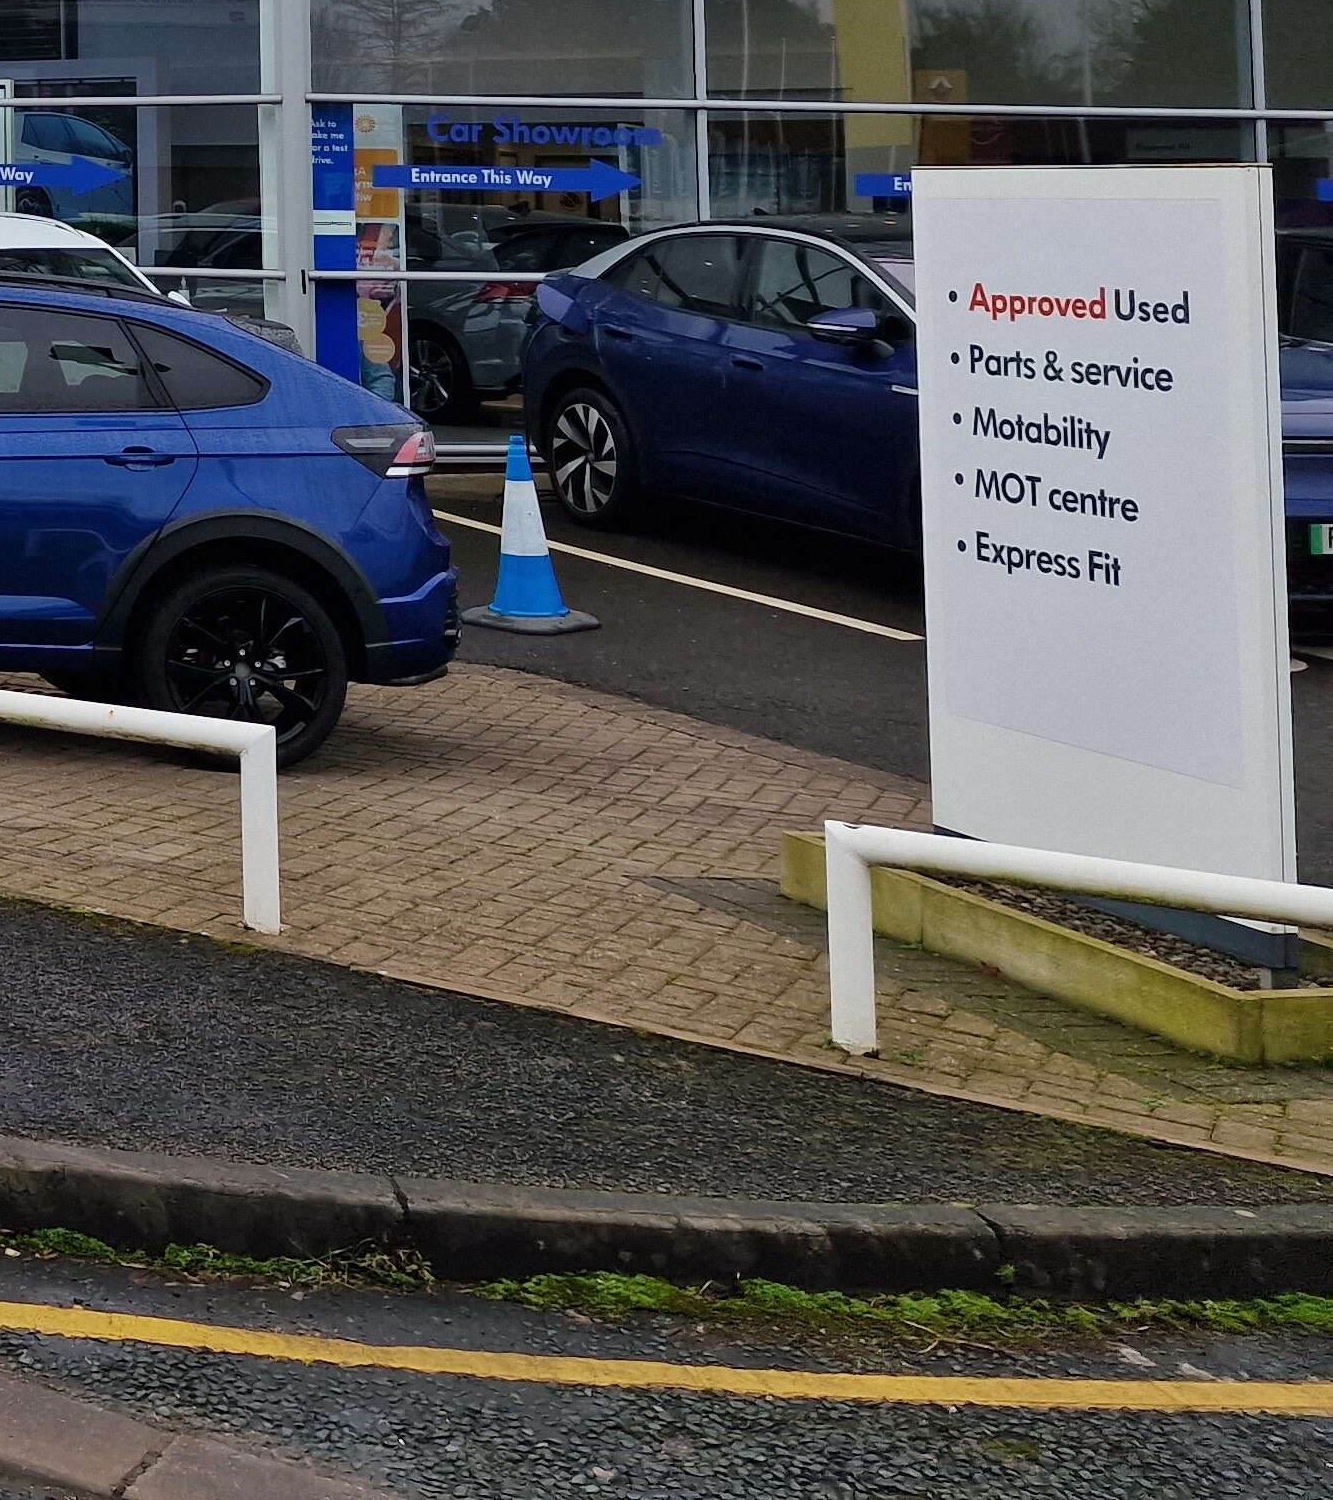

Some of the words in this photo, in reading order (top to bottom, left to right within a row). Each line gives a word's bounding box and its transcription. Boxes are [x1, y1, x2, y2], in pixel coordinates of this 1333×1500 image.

[312, 130, 327, 139] ake
[427, 113, 482, 144] Car
[493, 115, 663, 146] Showroom
[411, 168, 477, 184] Entrance
[482, 169, 512, 185] This
[516, 170, 552, 188] Way
[968, 282, 1106, 321] Approved
[1114, 289, 1190, 325] Used
[969, 344, 1036, 380] Parts
[1043, 350, 1065, 382] &
[1070, 356, 1174, 392] service
[972, 406, 1111, 460] Motability
[974, 468, 1042, 507] MOT
[1048, 488, 1139, 522] centre
[976, 531, 1081, 579] Express
[1088, 550, 1121, 586] Fit
